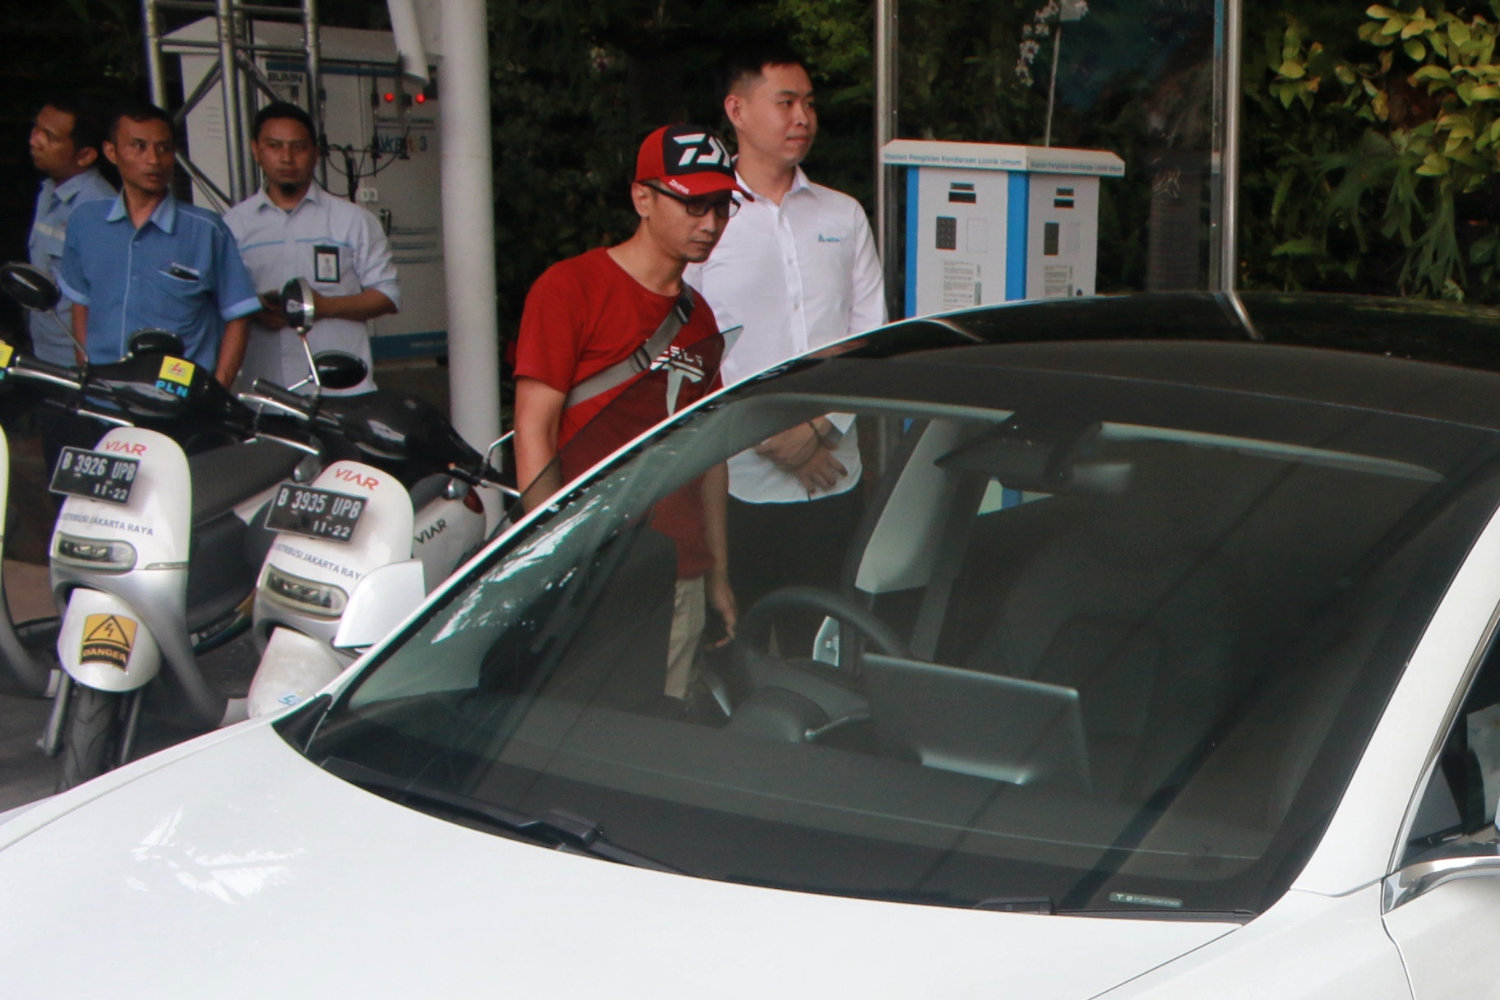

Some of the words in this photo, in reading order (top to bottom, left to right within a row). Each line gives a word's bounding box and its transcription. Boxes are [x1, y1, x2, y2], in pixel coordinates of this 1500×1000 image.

[156, 380, 189, 398] PLN
[105, 441, 147, 456] VIAR
[61, 451, 72, 470] B
[74, 454, 108, 476] 3926
[111, 461, 136, 482] UPB
[335, 467, 379, 492] VIAR
[277, 487, 289, 506] B
[291, 490, 328, 513] 3935
[331, 497, 362, 519] UPB
[88, 516, 125, 530] JAKARTA
[126, 523, 153, 536] RAYA
[413, 518, 447, 544] VIAR
[303, 552, 340, 574] JAKARTA
[341, 565, 363, 581] RAY
[82, 647, 127, 663] DANGER
